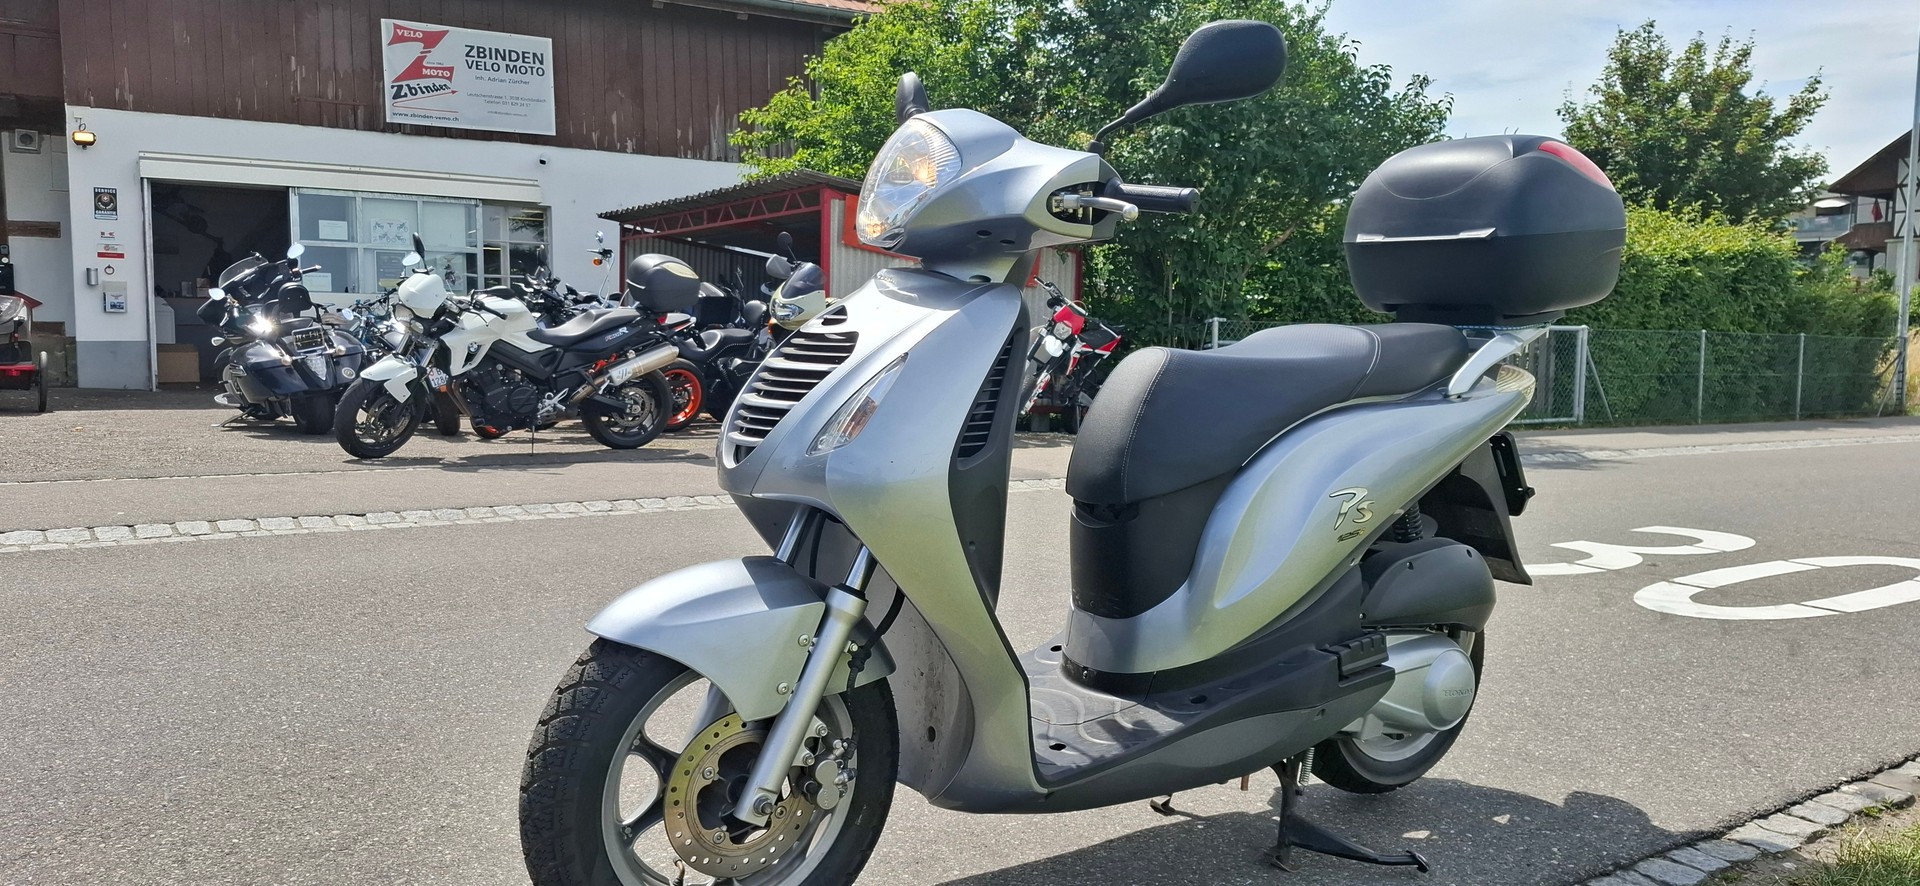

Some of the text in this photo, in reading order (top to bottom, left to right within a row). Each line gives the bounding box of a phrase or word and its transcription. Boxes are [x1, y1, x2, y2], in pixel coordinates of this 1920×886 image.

[396, 29, 423, 38] VELO
[464, 44, 544, 66] ZBINDEN
[422, 68, 450, 77] MOTO
[465, 59, 545, 77] VELO MOTO
[390, 82, 451, 100] Zbinden
[392, 112, 460, 122] www.zbinden-vemo.ch
[1524, 526, 1920, 620] 30
[1443, 688, 1473, 697] HONDA
